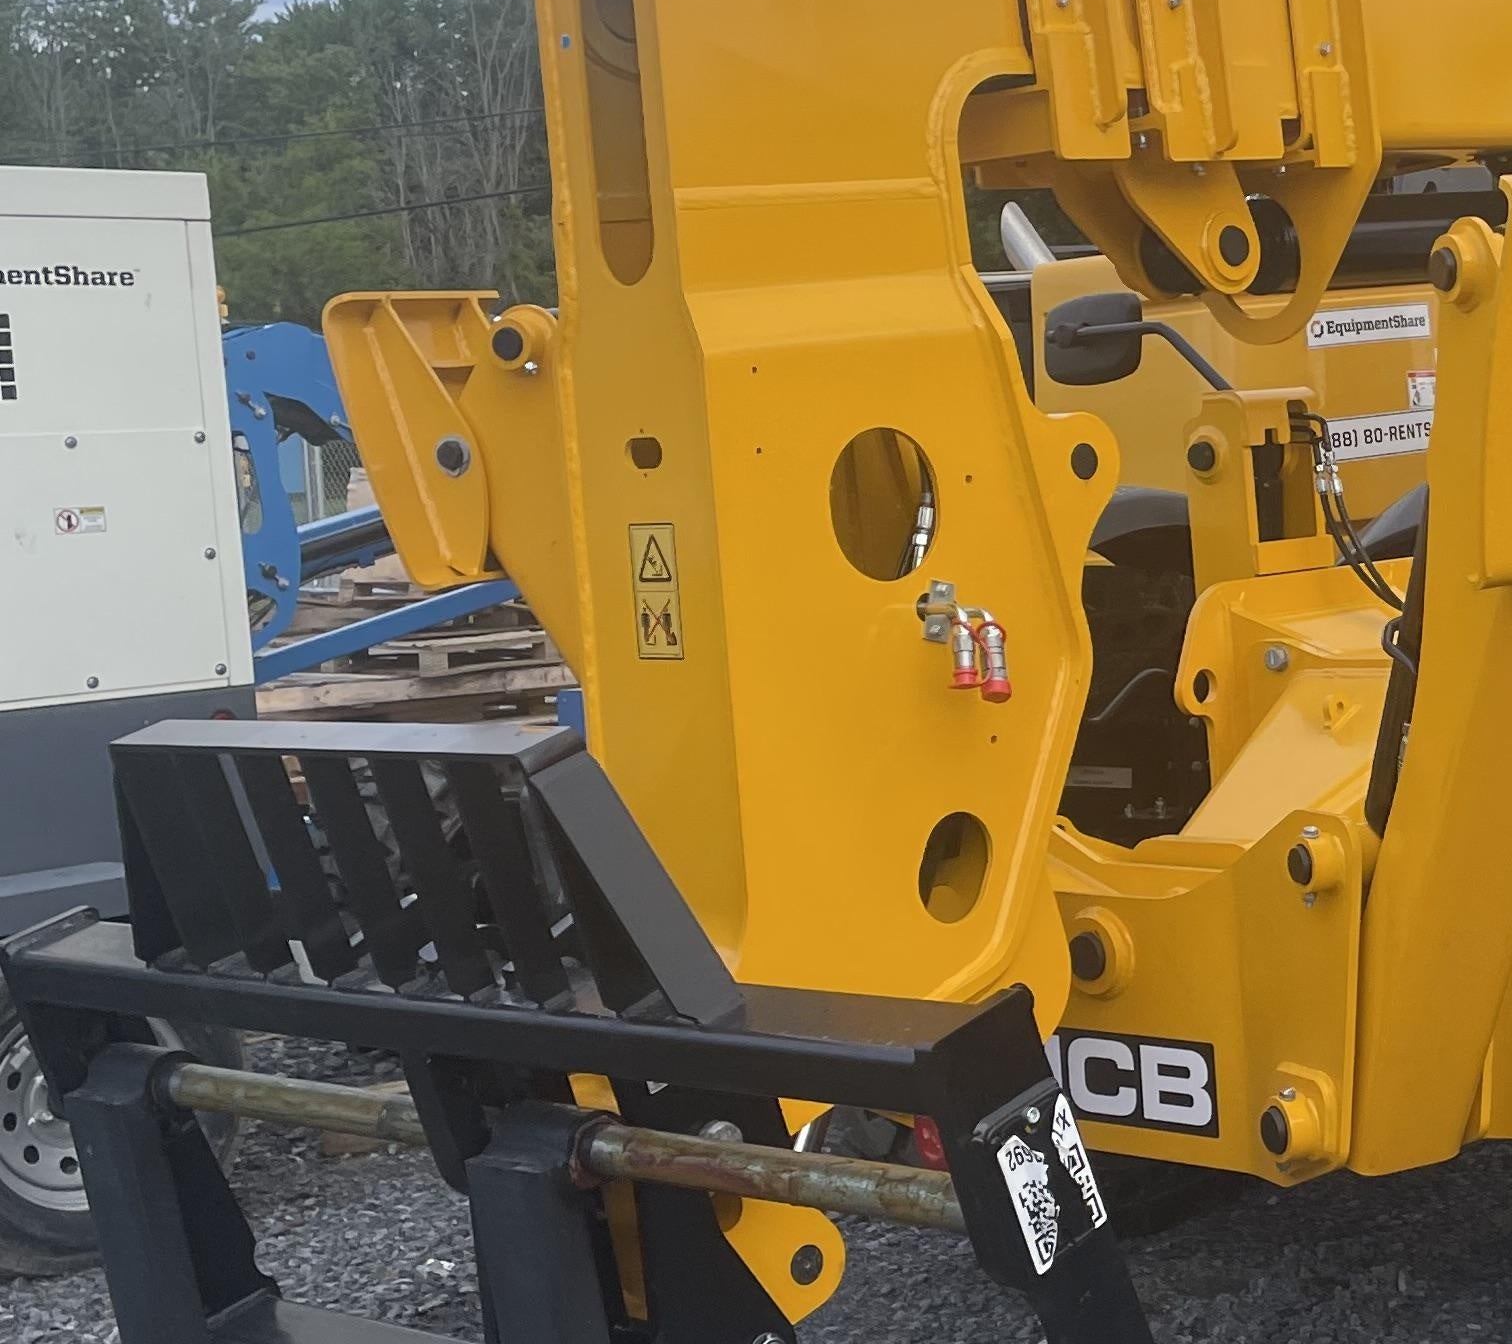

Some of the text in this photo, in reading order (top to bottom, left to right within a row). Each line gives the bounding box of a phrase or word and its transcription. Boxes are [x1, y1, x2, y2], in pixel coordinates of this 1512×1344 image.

[0, 265, 135, 287] entShare
[1326, 315, 1426, 337] EquipmentShare
[1331, 422, 1431, 448] 88) 80-RENTS
